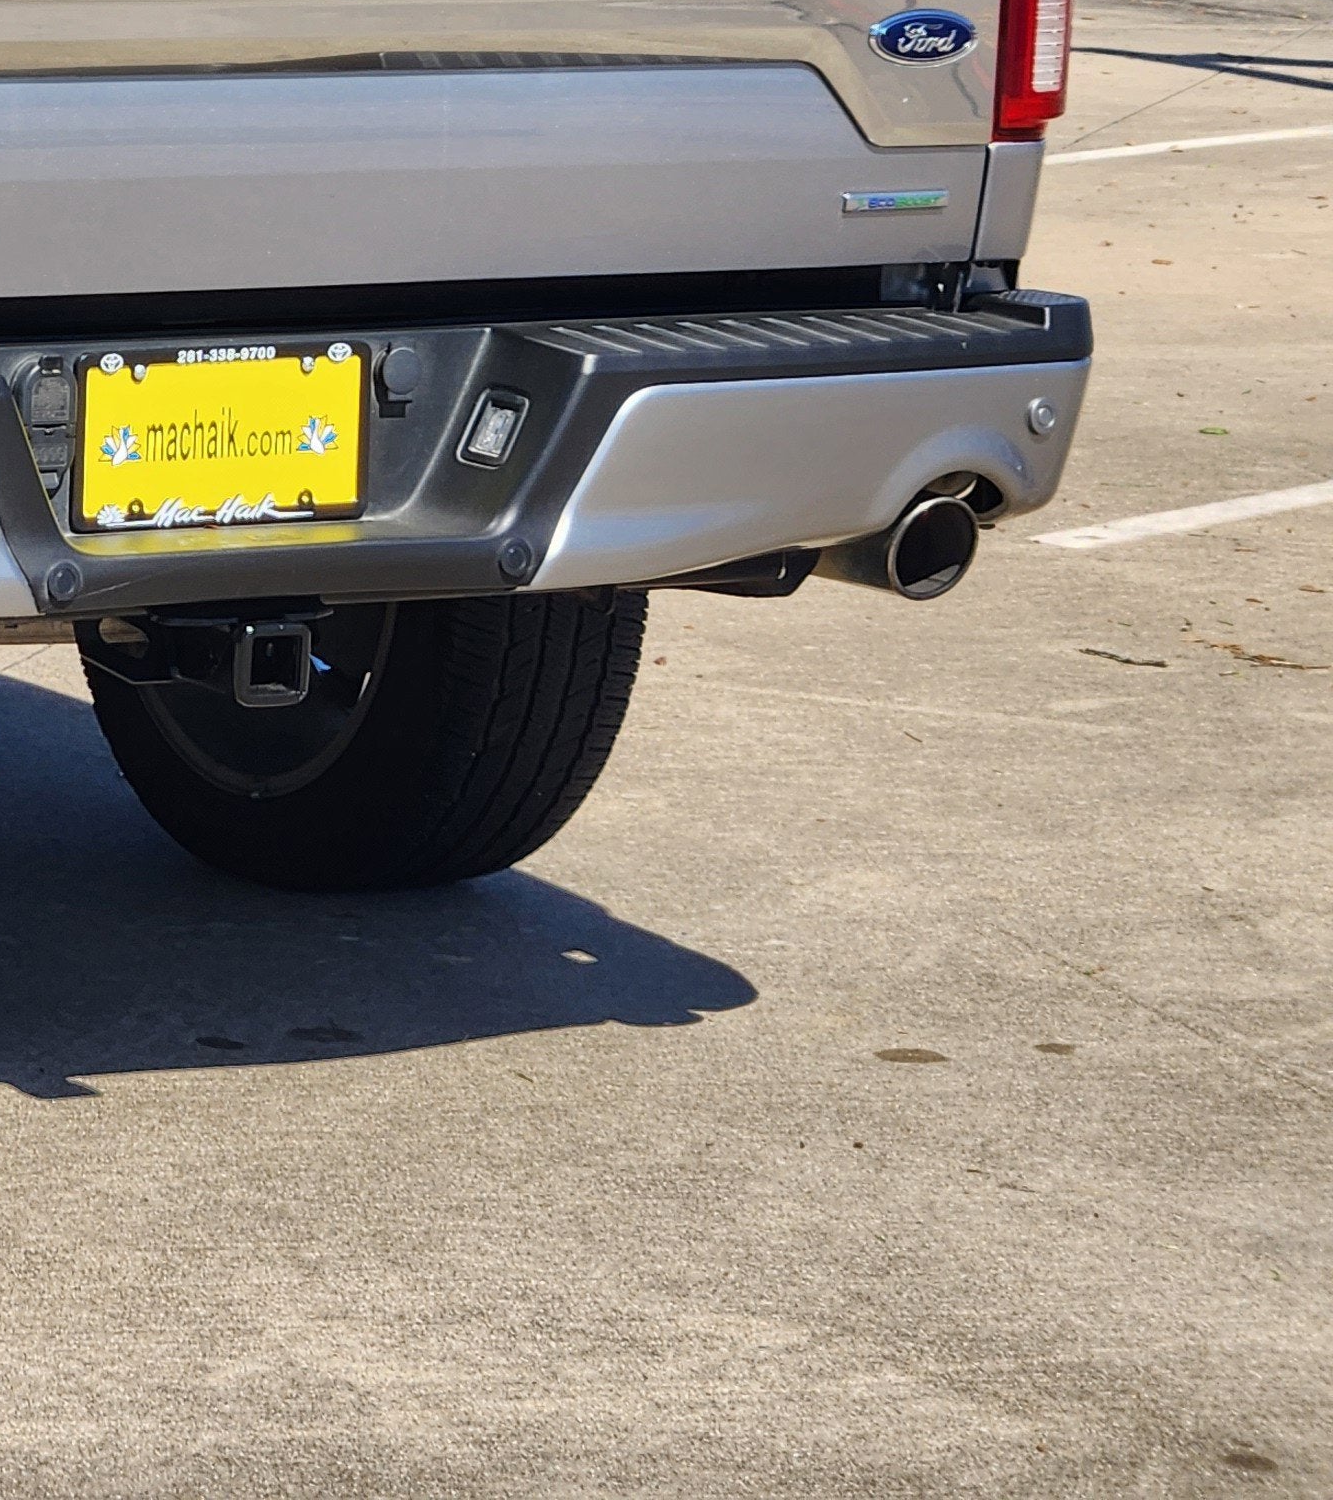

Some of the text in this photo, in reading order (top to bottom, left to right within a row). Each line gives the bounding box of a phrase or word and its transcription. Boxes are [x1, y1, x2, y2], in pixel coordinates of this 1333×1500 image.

[896, 21, 957, 54] Ford
[144, 406, 293, 463] machaik.com
[151, 496, 211, 529] Mac
